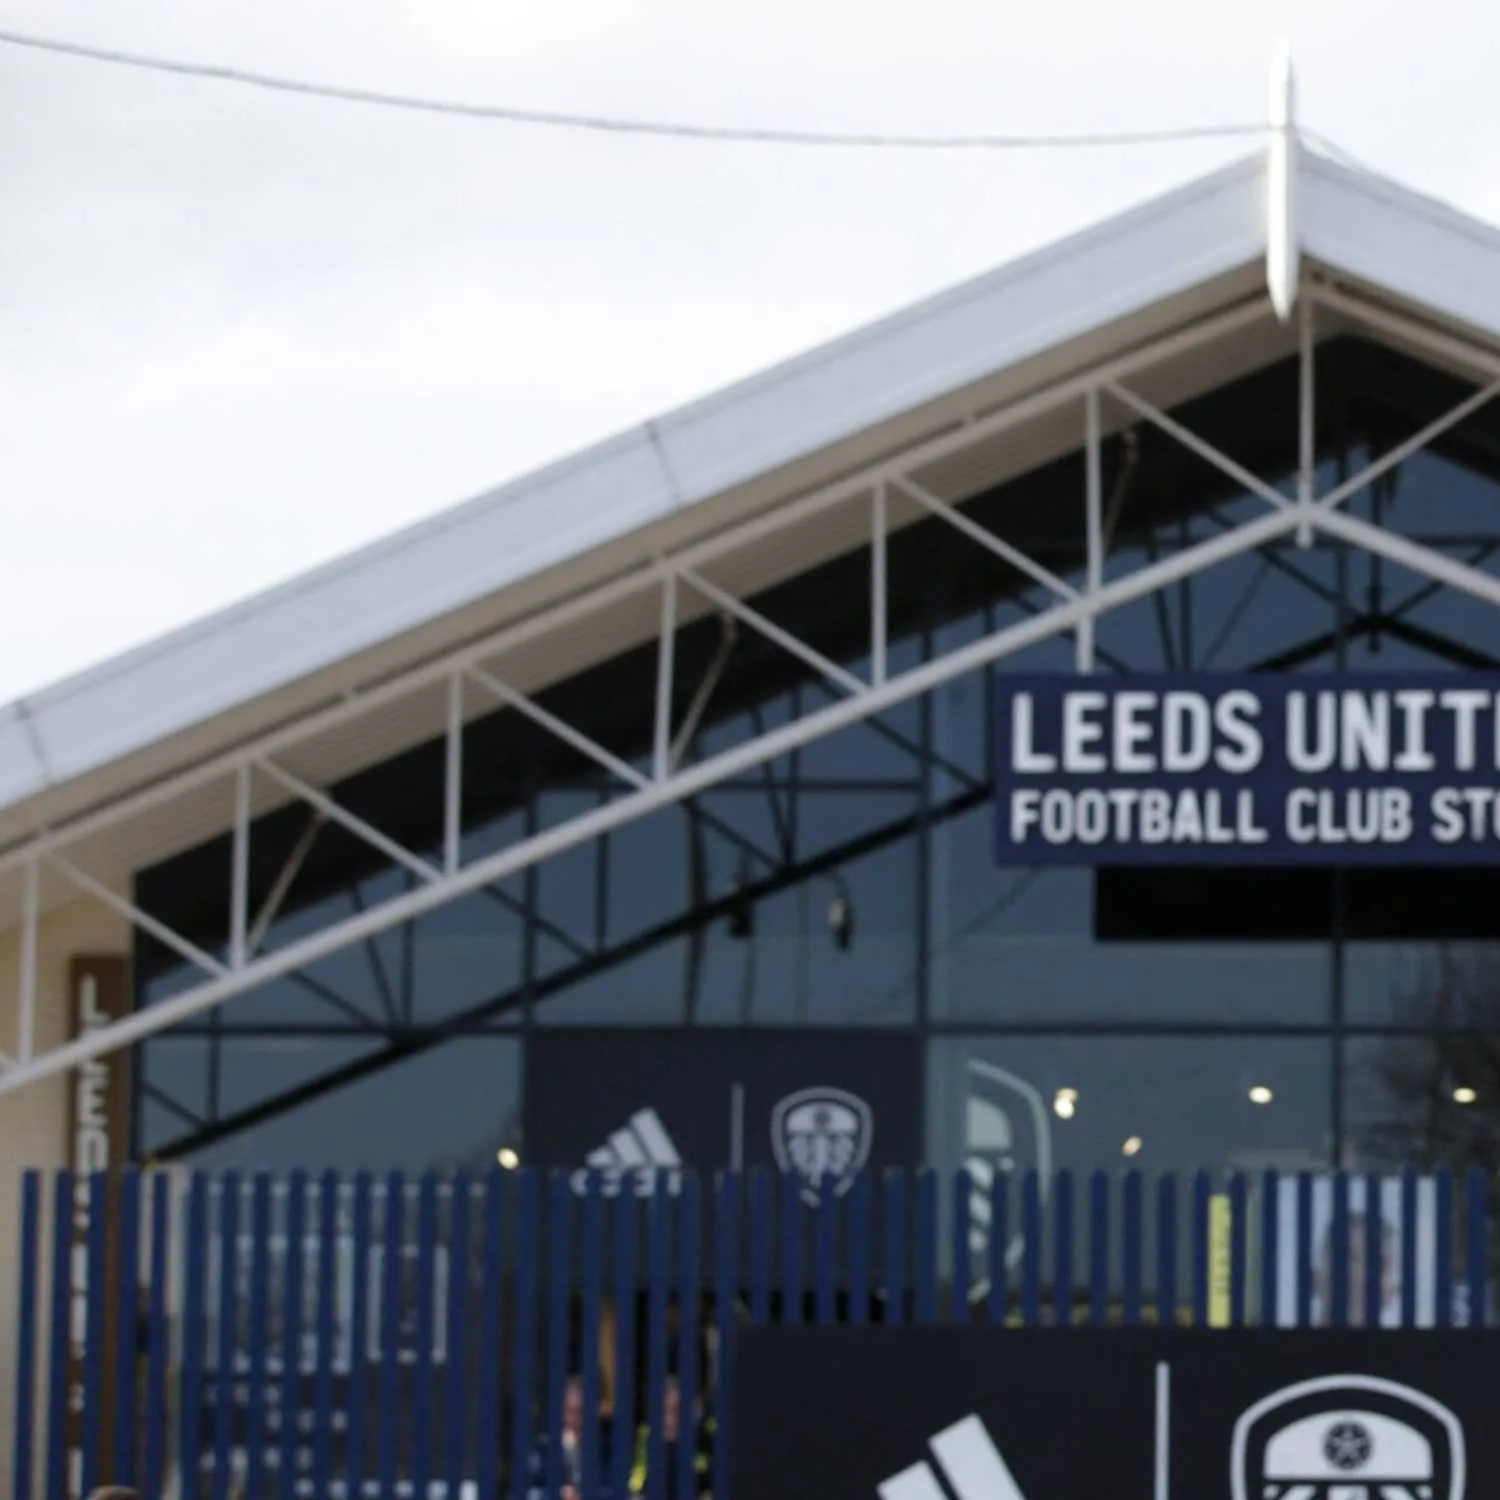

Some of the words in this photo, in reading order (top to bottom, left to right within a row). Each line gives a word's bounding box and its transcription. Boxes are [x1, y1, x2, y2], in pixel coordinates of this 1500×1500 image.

[1011, 691, 1262, 773] LEEDS
[1011, 788, 1267, 843] FOOTBALL
[1286, 788, 1412, 843] CLUB
[74, 975, 109, 1230] LED
